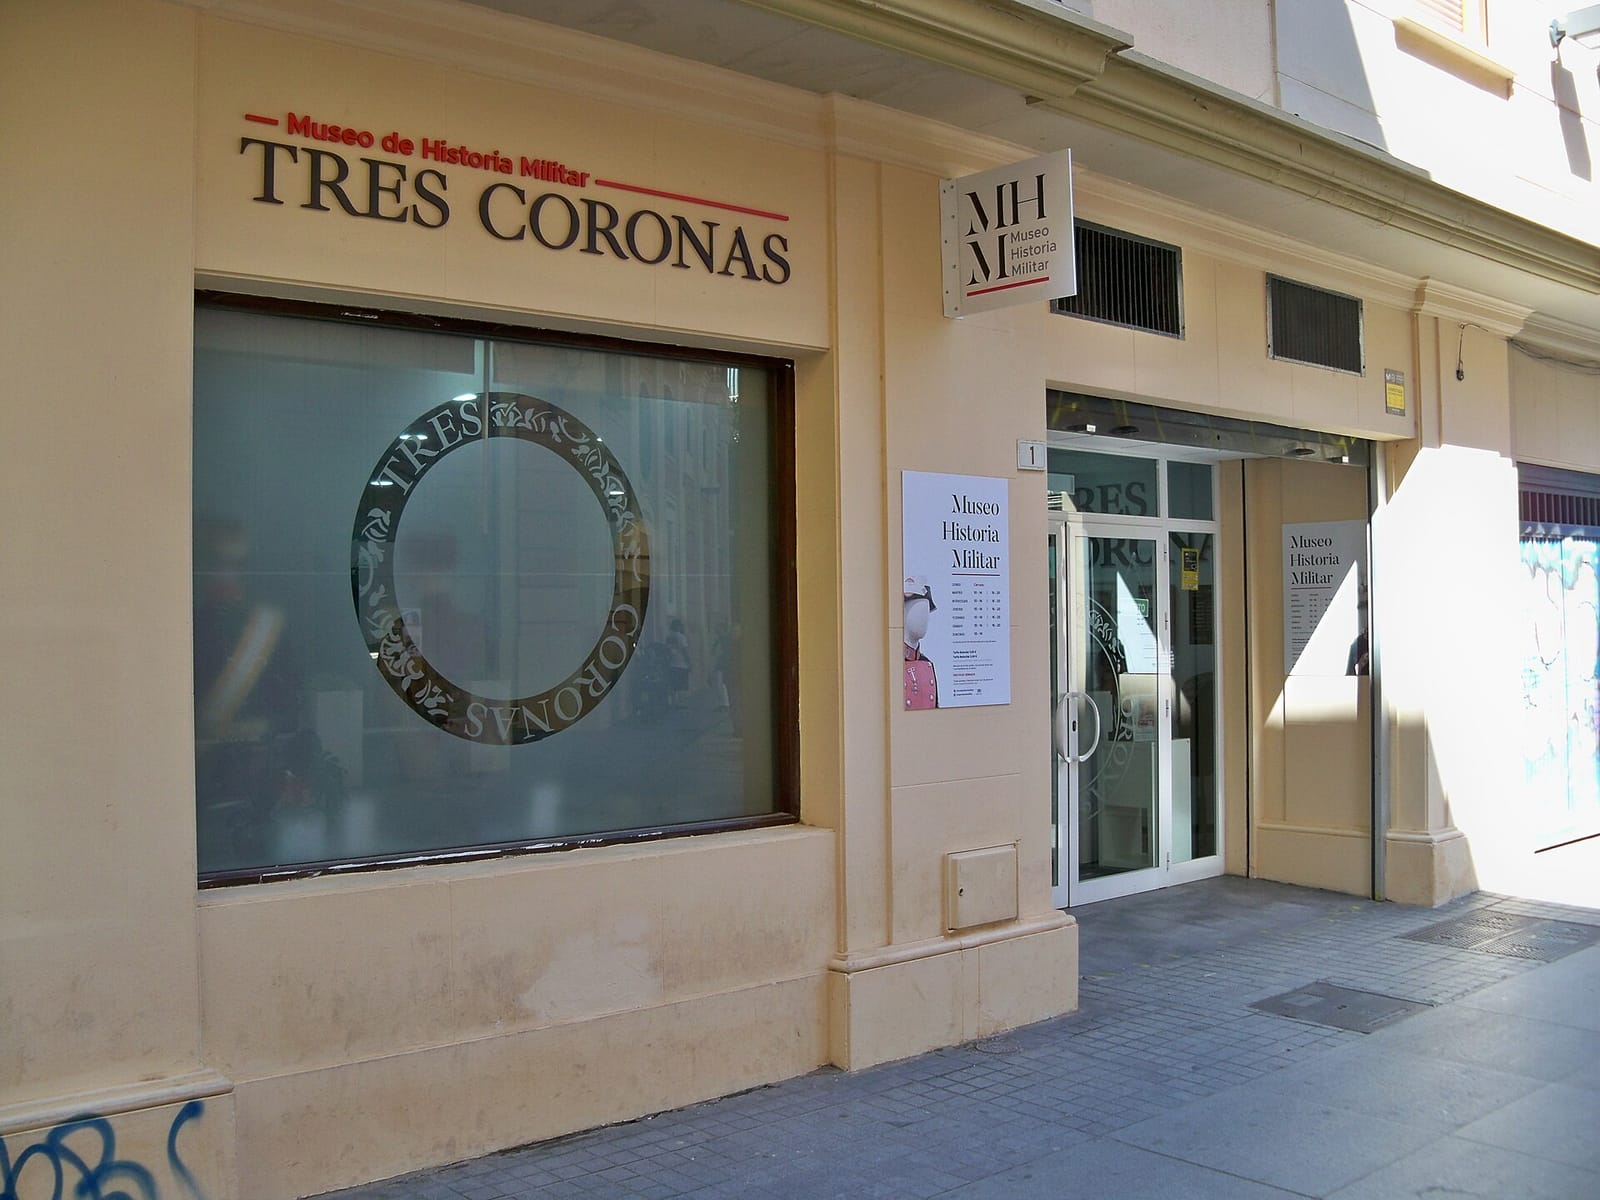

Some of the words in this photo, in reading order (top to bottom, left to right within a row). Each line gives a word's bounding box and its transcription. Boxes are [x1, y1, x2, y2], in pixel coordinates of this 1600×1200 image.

[286, 112, 374, 148] Museo
[382, 131, 414, 155] de
[422, 137, 513, 174] Historia
[521, 156, 590, 188] Militar
[240, 136, 450, 229] TRES
[478, 182, 791, 285] CORONAS
[964, 174, 1047, 237] MH
[1010, 227, 1049, 244] Museo
[966, 233, 1010, 286] M
[1010, 241, 1057, 260] Historia
[1012, 260, 1049, 276] Militar
[378, 401, 482, 496] TRES
[1029, 446, 1035, 465] 1
[952, 494, 1000, 516] Museo
[943, 521, 1000, 543] Historia
[1290, 535, 1332, 549] Museo
[952, 549, 1000, 569] Militar
[1290, 553, 1339, 567] Historia
[1291, 571, 1334, 585] Militar
[465, 603, 639, 741] CORONAS
